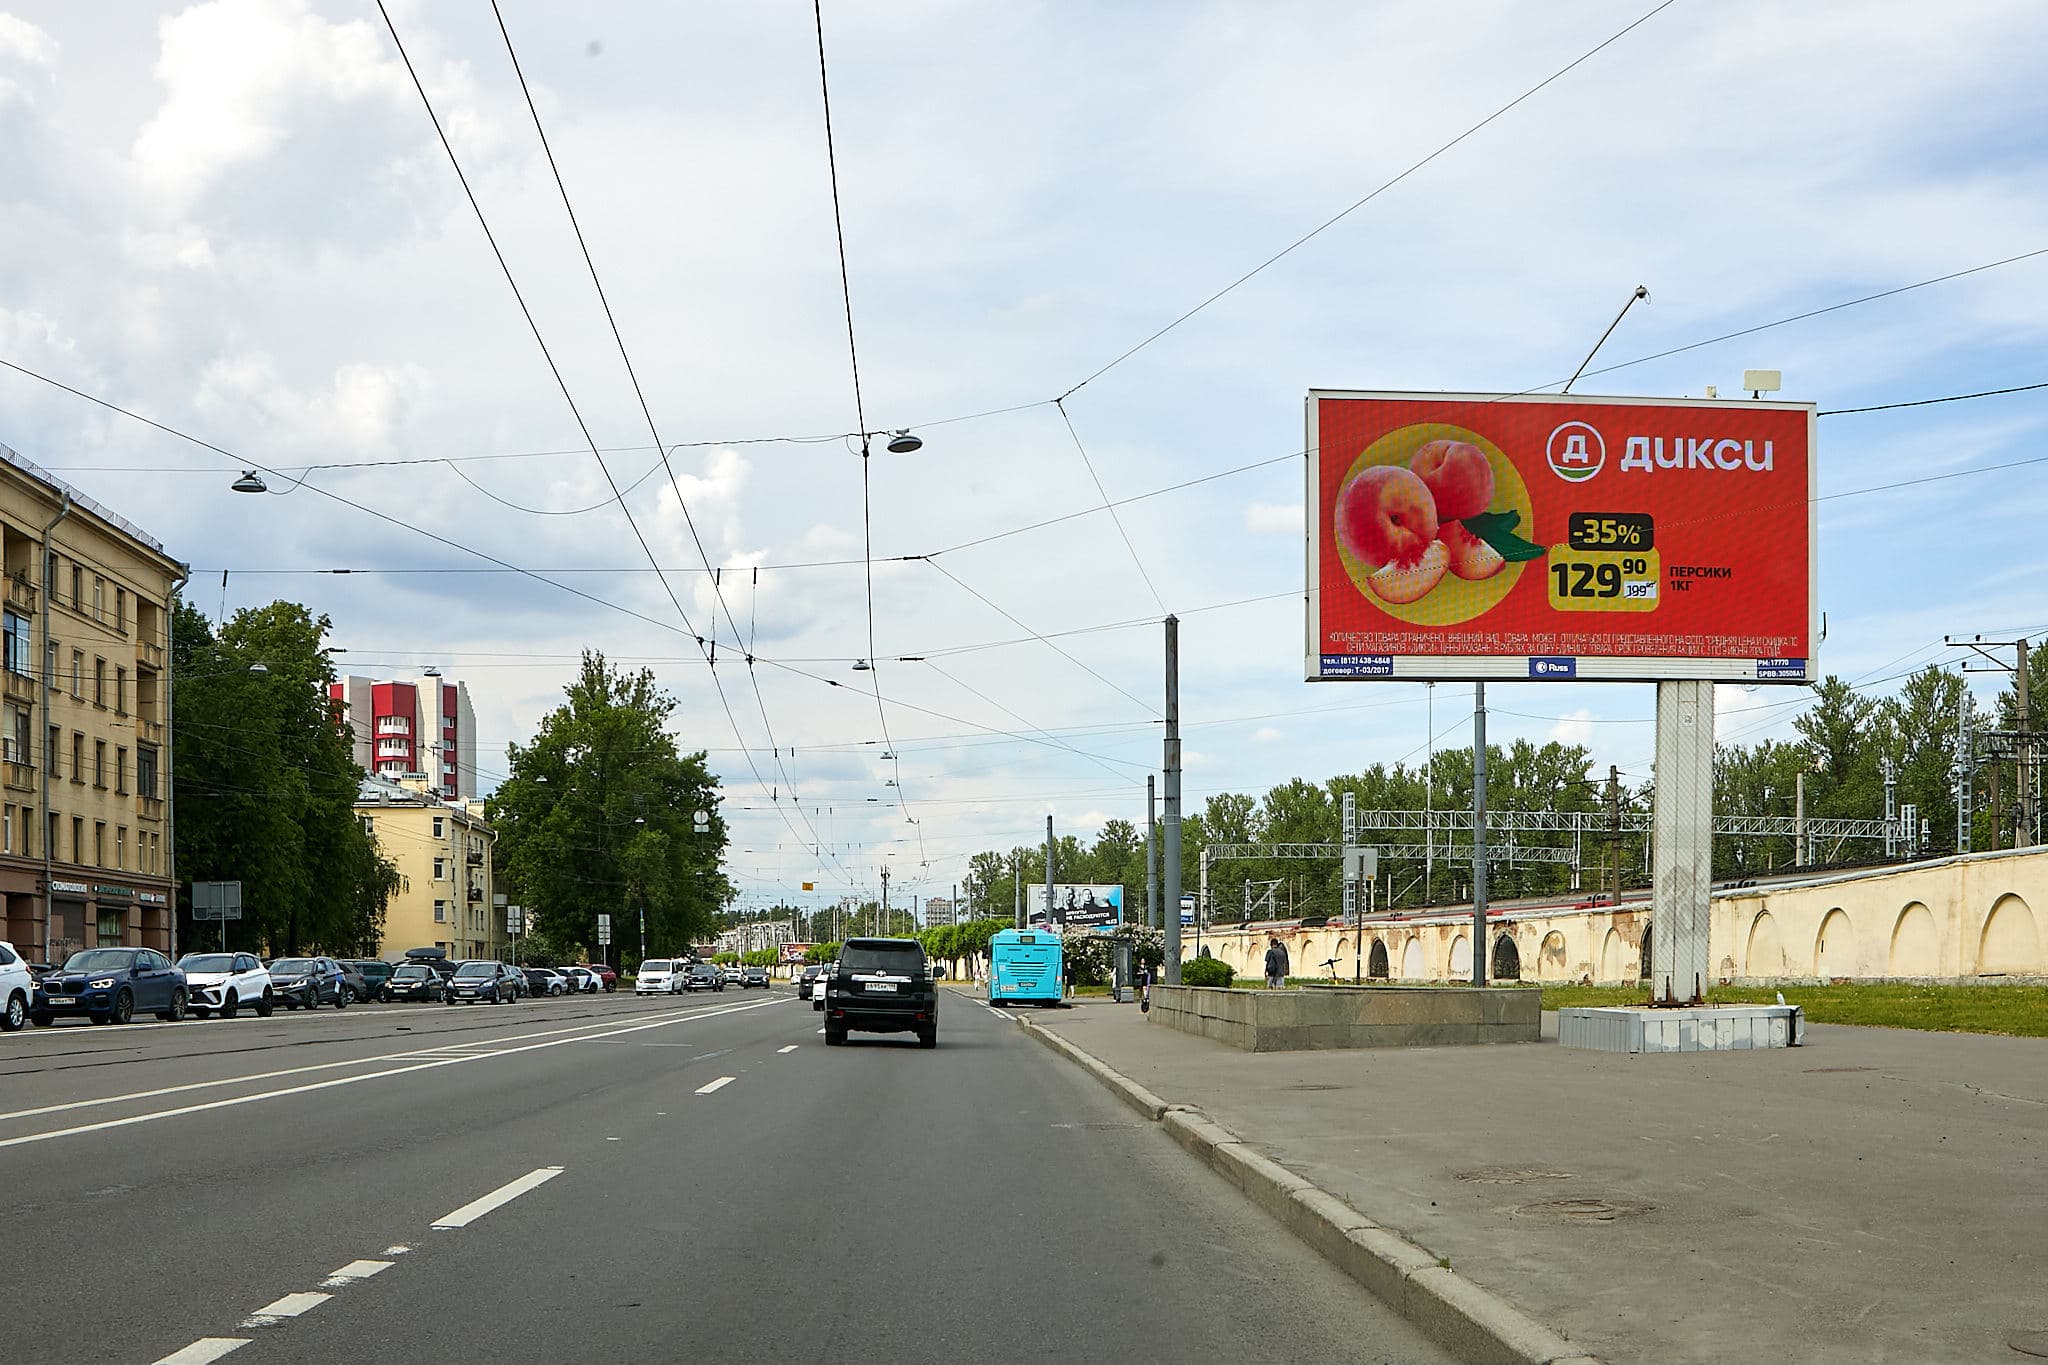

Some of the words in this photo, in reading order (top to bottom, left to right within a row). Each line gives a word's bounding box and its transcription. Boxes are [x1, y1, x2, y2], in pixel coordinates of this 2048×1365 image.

[1669, 566, 1731, 578] ПЕРСИКИ
[1551, 563, 1621, 597] 129
[1670, 580, 1693, 591] 1КГ
[1549, 663, 1569, 672] Russ
